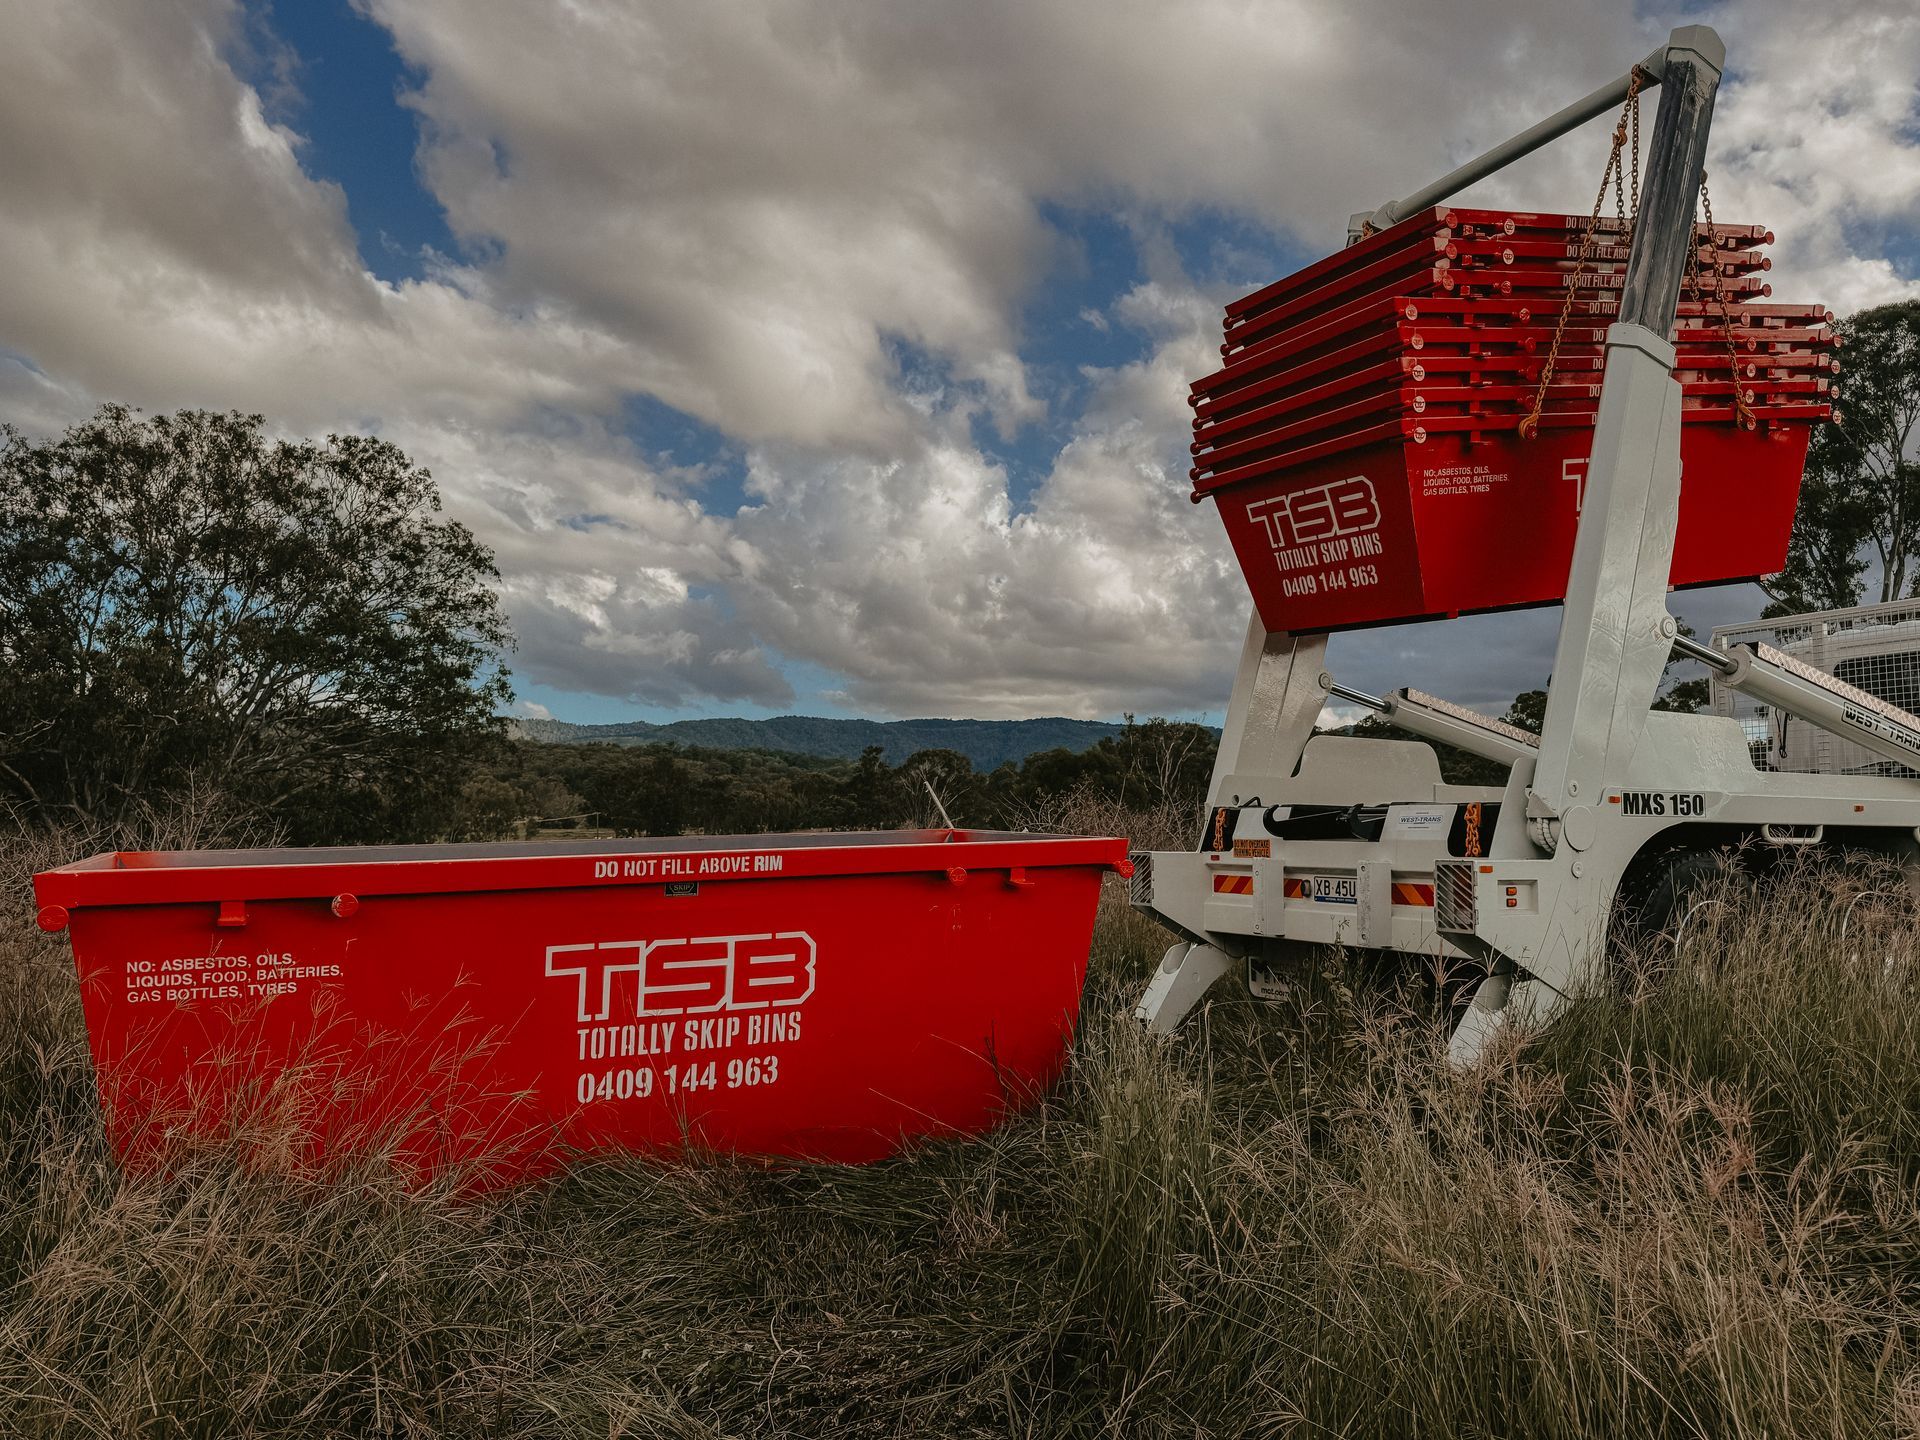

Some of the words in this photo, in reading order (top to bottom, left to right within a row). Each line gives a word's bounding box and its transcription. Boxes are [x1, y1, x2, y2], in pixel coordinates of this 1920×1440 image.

[1565, 216, 1577, 229] DO
[1566, 245, 1578, 257] DO
[1596, 247, 1612, 258] FILL
[1613, 248, 1631, 259] ABO
[1592, 276, 1608, 287] FILL
[1589, 302, 1600, 314] DO
[1602, 302, 1618, 314] NOT
[1593, 330, 1604, 342] DO
[1593, 358, 1604, 370] DO
[1589, 385, 1600, 397] DO
[1423, 488, 1437, 496] GAS
[1470, 484, 1490, 493] TYRES
[1246, 475, 1381, 549] TSB
[1274, 545, 1319, 571] TOTALLY
[1320, 539, 1349, 564] SKIP
[1350, 532, 1383, 558] BINS
[1282, 574, 1317, 598] 0409
[1319, 569, 1347, 592] 144
[1349, 564, 1378, 588] 963
[1845, 706, 1920, 750] WEST-TRAN
[1622, 792, 1665, 816] MXS
[1669, 793, 1704, 816] 150
[595, 861, 619, 878] DO
[624, 860, 657, 876] NOT
[661, 858, 694, 875] FILL
[699, 856, 750, 874] ABOVE
[754, 855, 783, 872] RIM
[126, 960, 156, 973] NO:
[160, 955, 252, 971] ASBESTOS,
[256, 952, 296, 966] OILS,
[127, 973, 197, 989] LIQUIDS,
[202, 970, 251, 984] FOOD,
[256, 964, 344, 981] BATTERIES,
[545, 931, 816, 1022] TSB
[127, 990, 162, 1003] GAS
[166, 985, 243, 1001] BOTTLES,
[248, 982, 297, 996] TYRES
[577, 1022, 676, 1060] TOTALLY
[684, 1017, 740, 1051] SKIP
[747, 1011, 801, 1045] BINS
[577, 1067, 653, 1104] 0409
[664, 1061, 717, 1094] 144
[727, 1055, 779, 1088] 963
